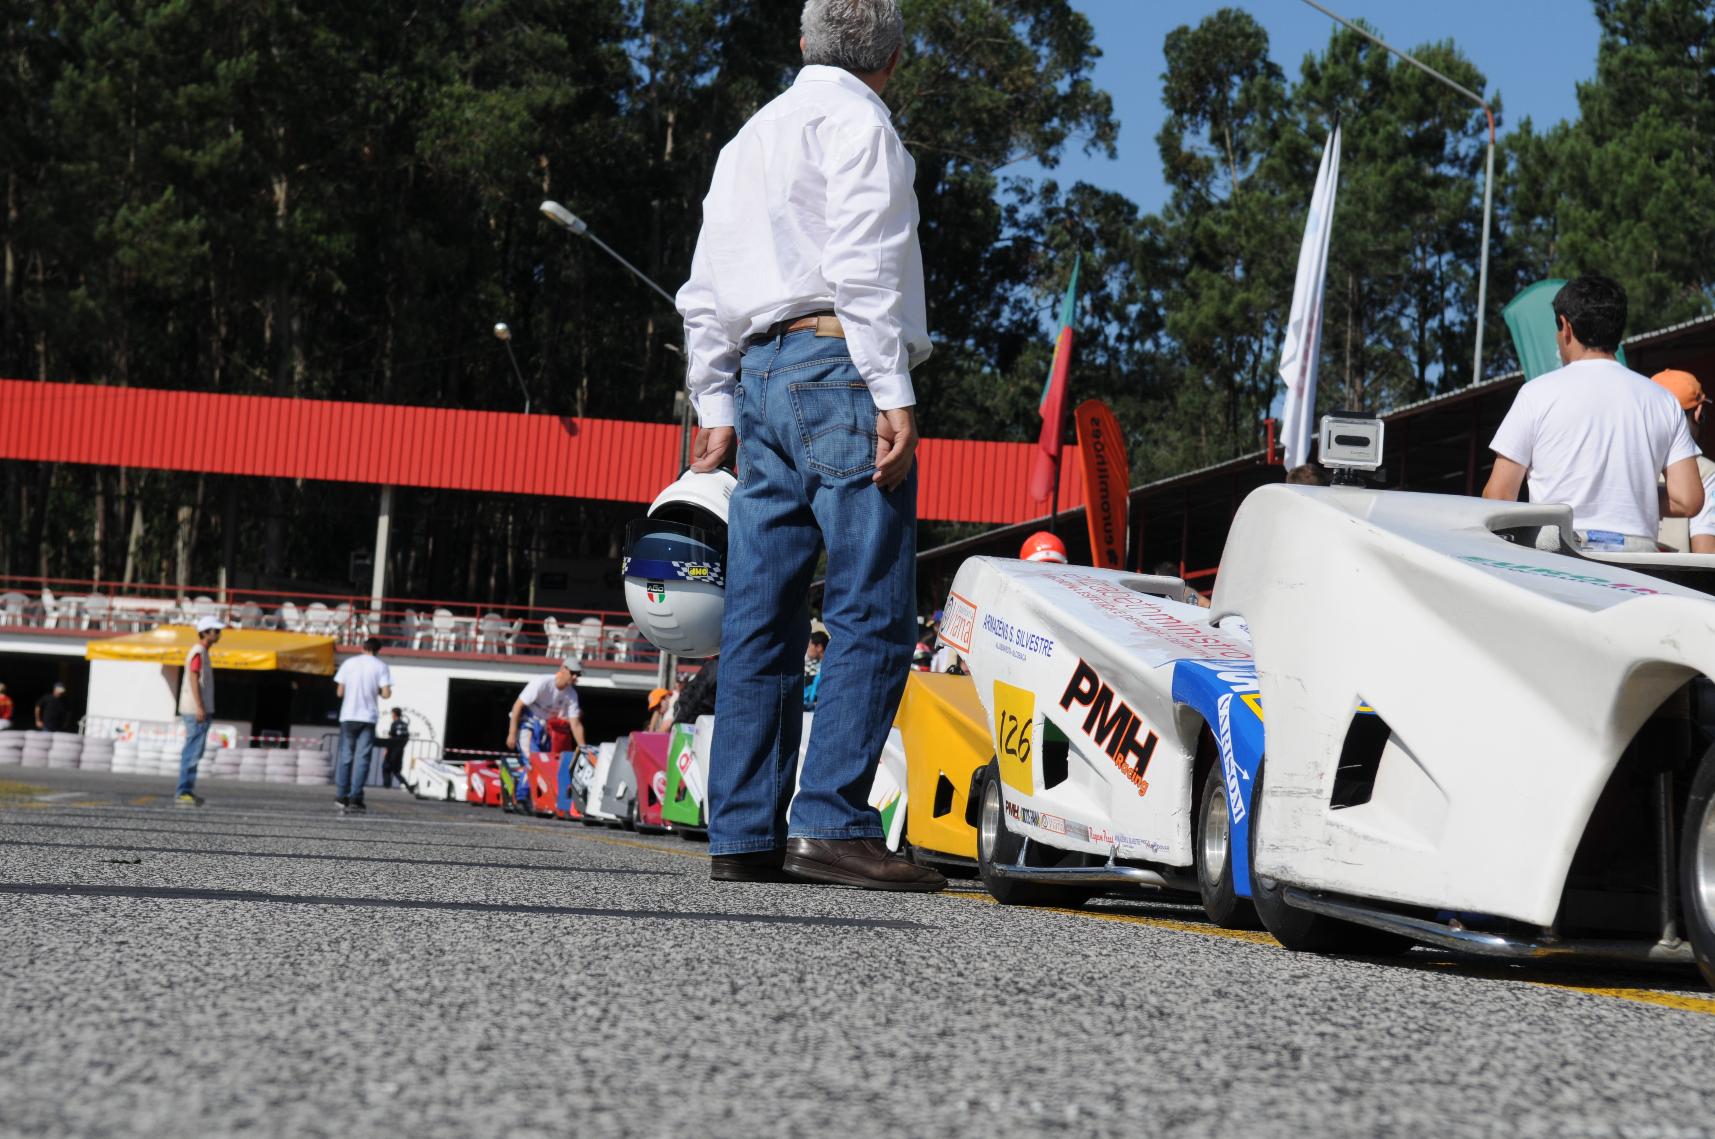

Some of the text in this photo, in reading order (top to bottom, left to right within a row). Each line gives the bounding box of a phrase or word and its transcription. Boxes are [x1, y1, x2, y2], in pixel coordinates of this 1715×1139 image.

[689, 567, 708, 576] OMP
[983, 614, 1009, 640] ARMAZÉNS
[1016, 629, 1054, 657] SILVESTRE
[1000, 710, 1033, 763] 126
[1059, 656, 1159, 779] PMH
[1114, 752, 1149, 797] Racing
